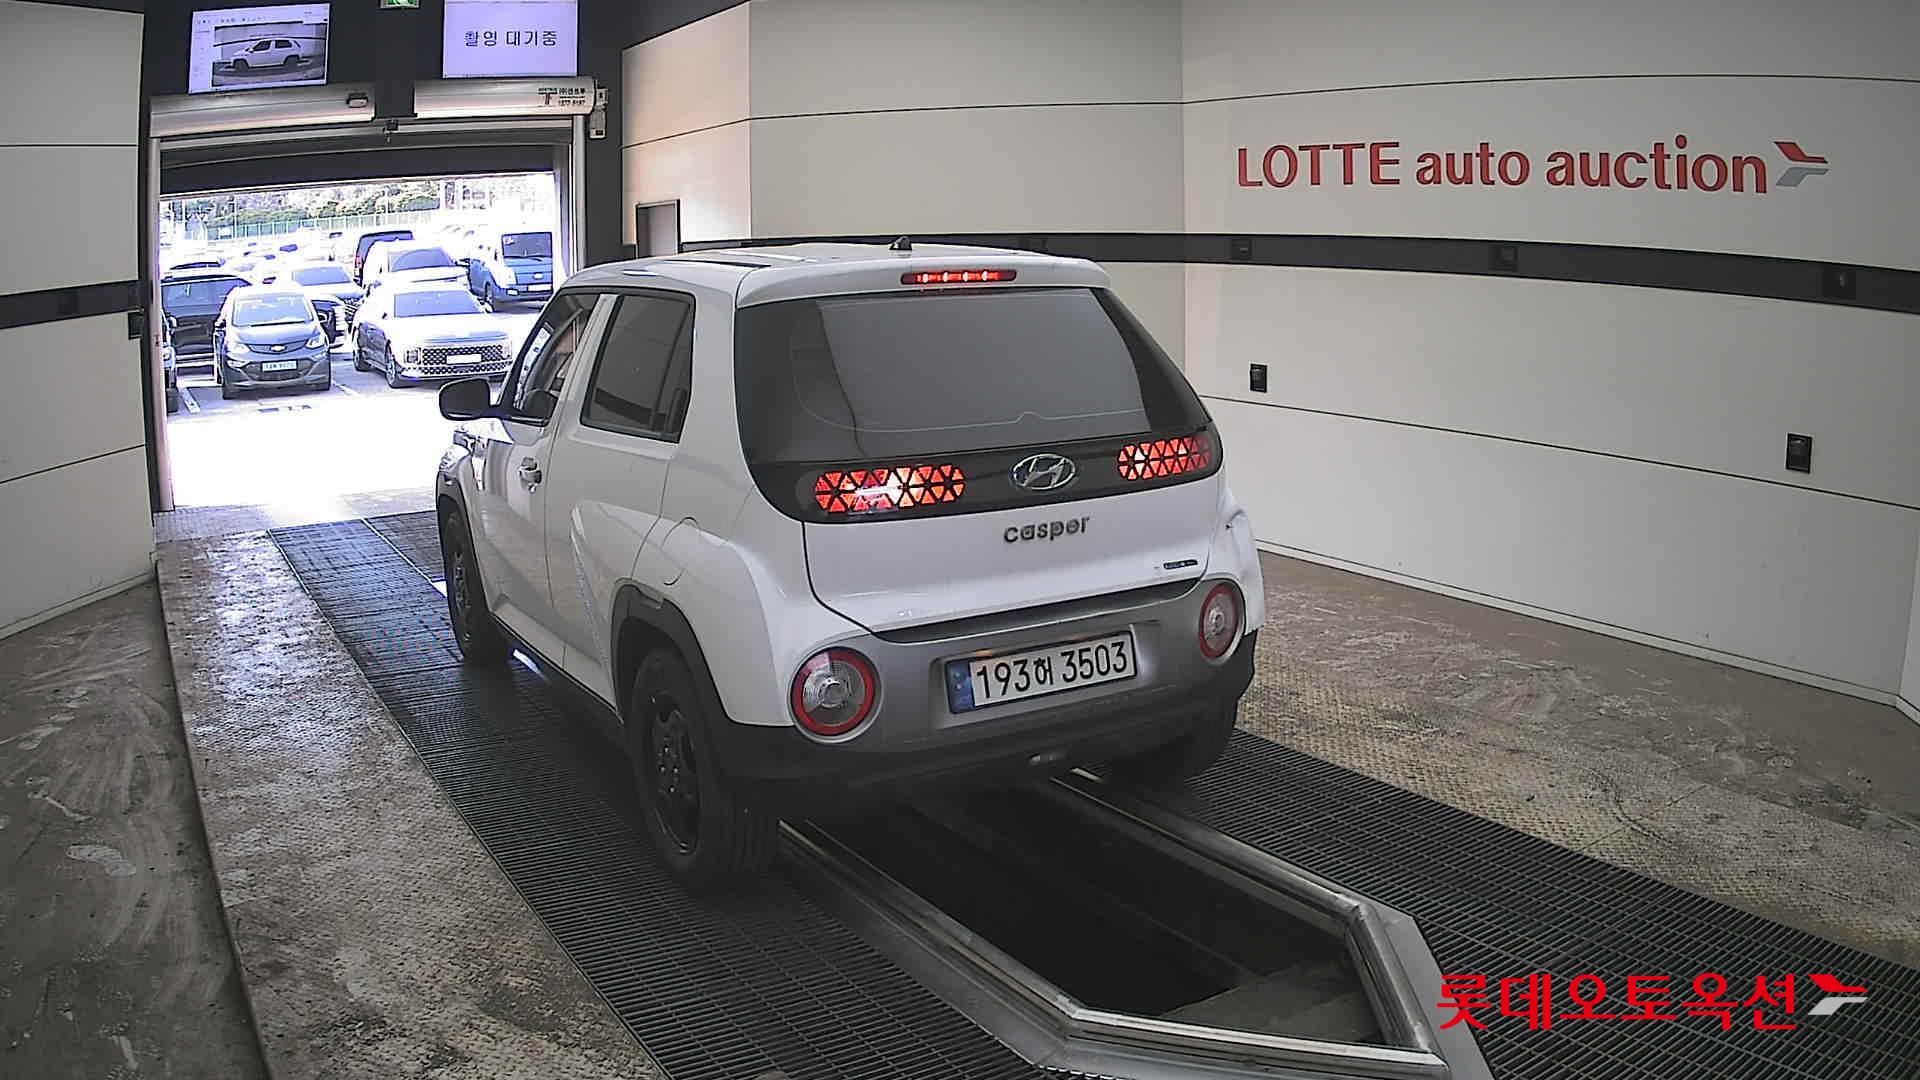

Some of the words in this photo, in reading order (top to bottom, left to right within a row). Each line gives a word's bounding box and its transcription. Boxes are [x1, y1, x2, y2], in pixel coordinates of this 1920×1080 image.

[506, 30, 558, 47] 대기중
[1237, 142, 1400, 188] LOTTE
[1417, 142, 1531, 186] auto
[1546, 135, 1767, 193] auction
[1003, 516, 1091, 544] casper
[976, 656, 1054, 699] 193허
[1060, 641, 1128, 684] 3503
